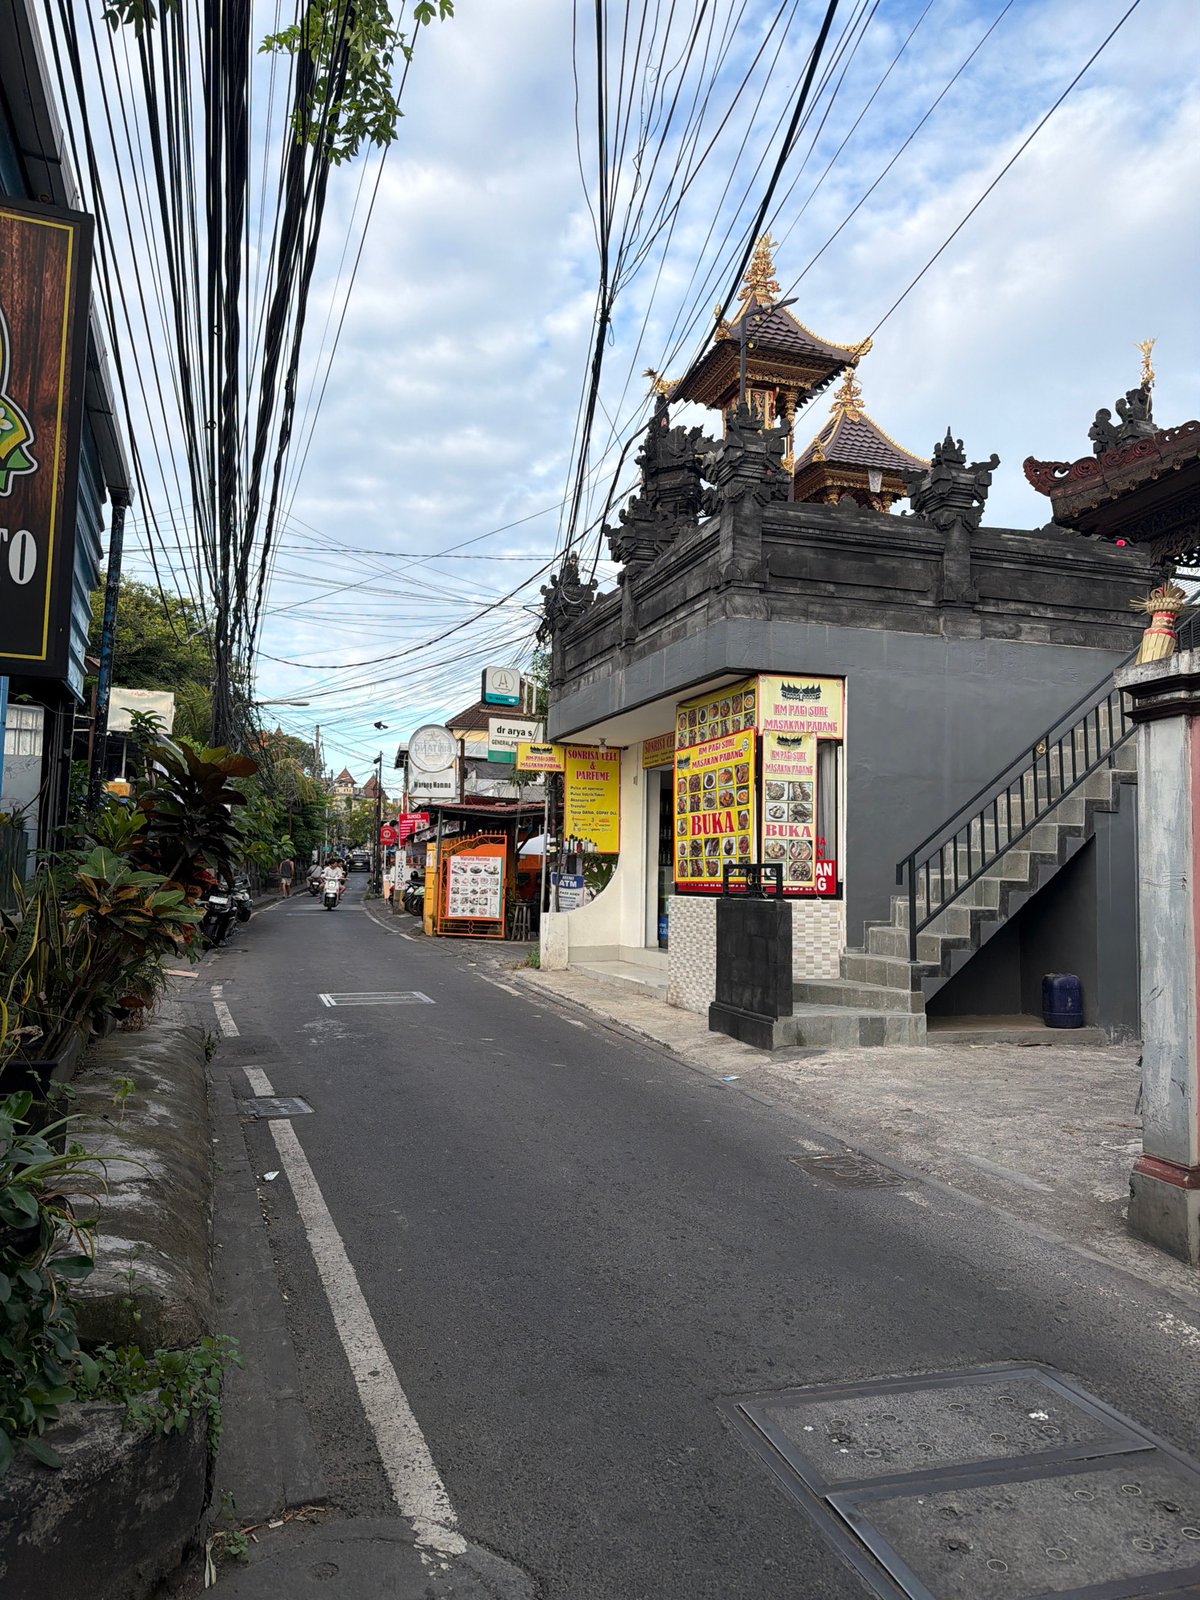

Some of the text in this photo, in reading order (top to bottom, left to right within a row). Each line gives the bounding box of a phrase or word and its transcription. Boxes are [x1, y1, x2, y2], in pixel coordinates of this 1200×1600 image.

[496, 725, 505, 734] dr
[507, 728, 526, 738] arya
[764, 719, 838, 733] MASAKAN PADANG
[568, 749, 599, 760] SONRISA
[692, 753, 719, 769] MASAKAN
[719, 749, 744, 764] PADANG
[589, 760, 597, 770] &
[576, 770, 610, 781] PARFUME
[691, 811, 735, 836] BUKA
[765, 825, 812, 837] BUKA
[559, 879, 577, 888] ATM
